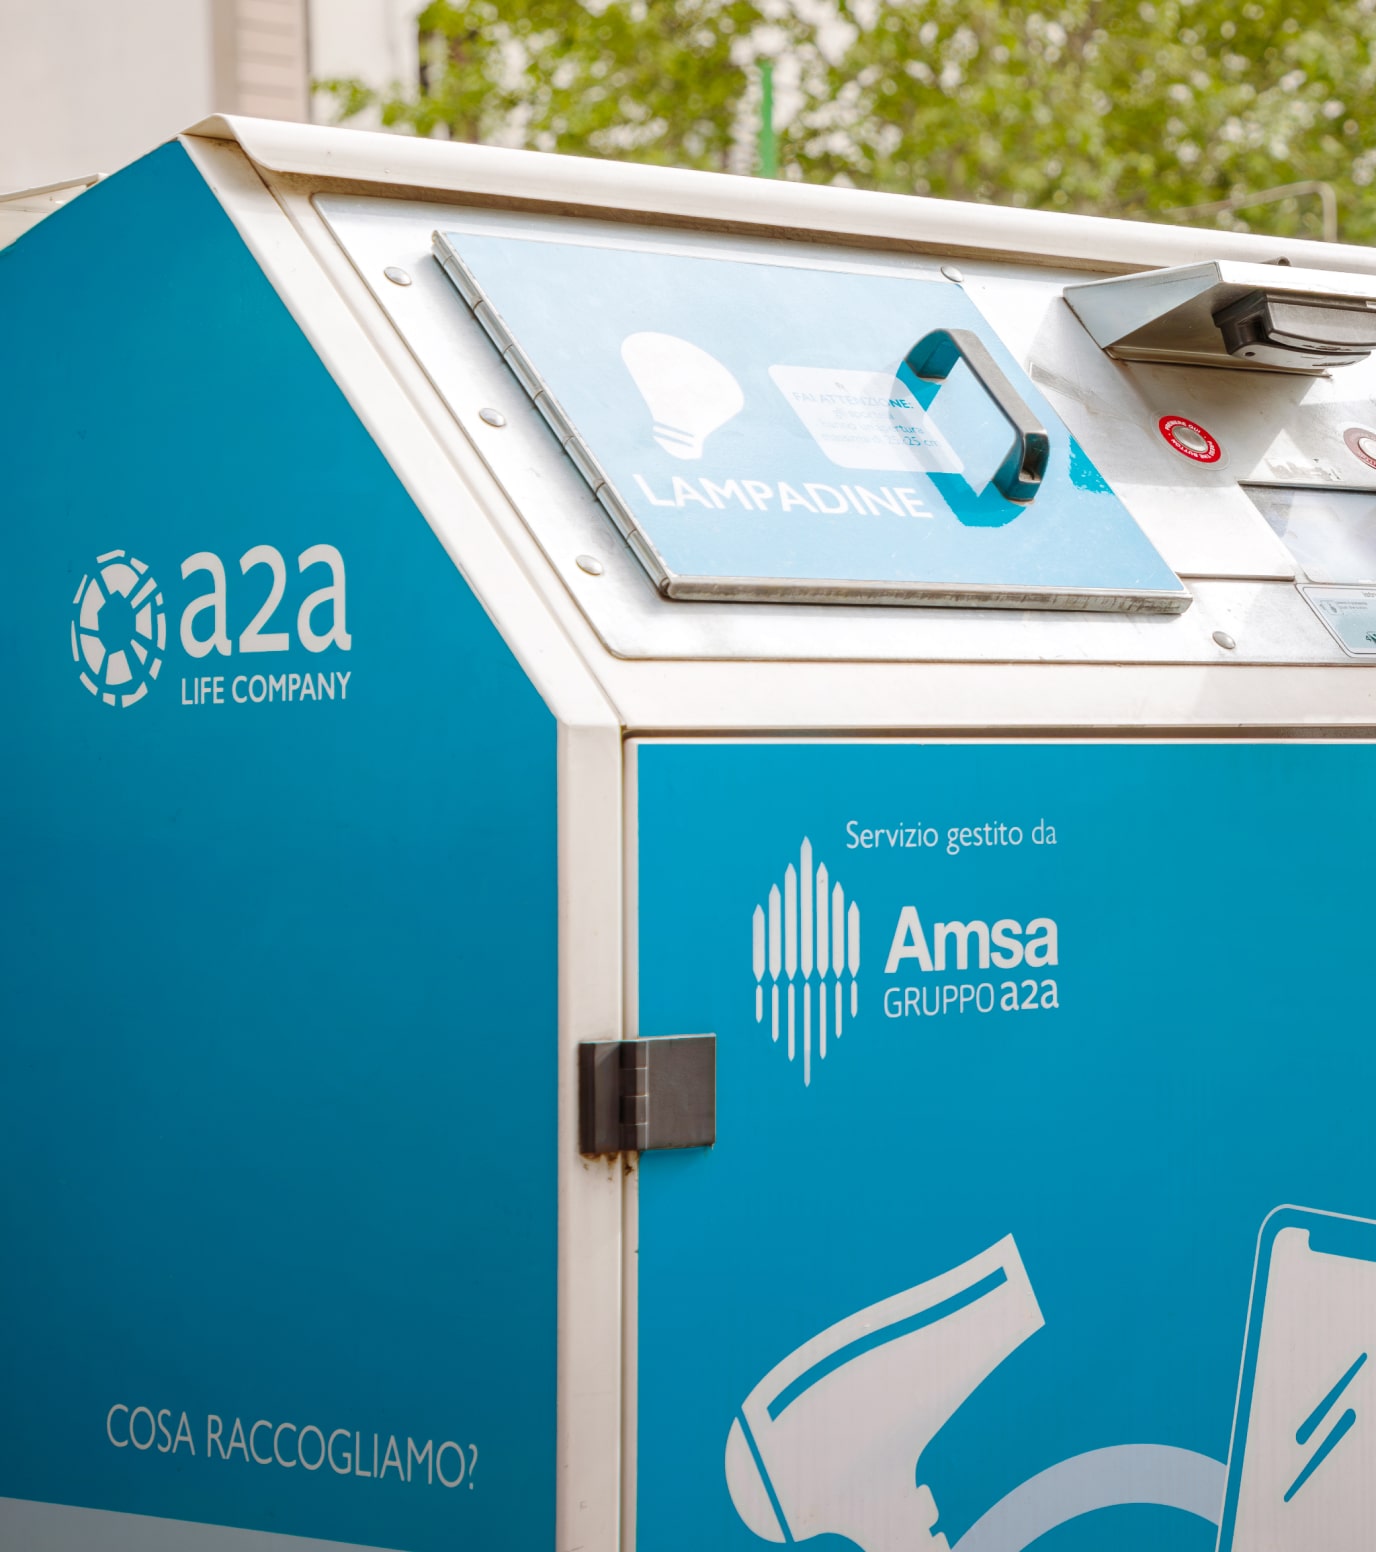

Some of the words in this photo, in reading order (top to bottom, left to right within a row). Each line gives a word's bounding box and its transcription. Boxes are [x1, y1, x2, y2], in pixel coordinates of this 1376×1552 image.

[632, 473, 934, 519] LAMPADINE
[180, 544, 352, 659] a2a
[181, 676, 225, 705] LIFE
[231, 671, 352, 703] COMPANY
[845, 819, 939, 849] Servizio
[946, 820, 1024, 856] gestito
[1031, 817, 1058, 846] da
[884, 905, 1059, 974] Amsa
[883, 982, 994, 1018] GRUPPO
[1000, 978, 1060, 1012] a2a
[106, 1403, 196, 1456] COSA
[207, 1414, 479, 1490] RACCOGLIAMO?
